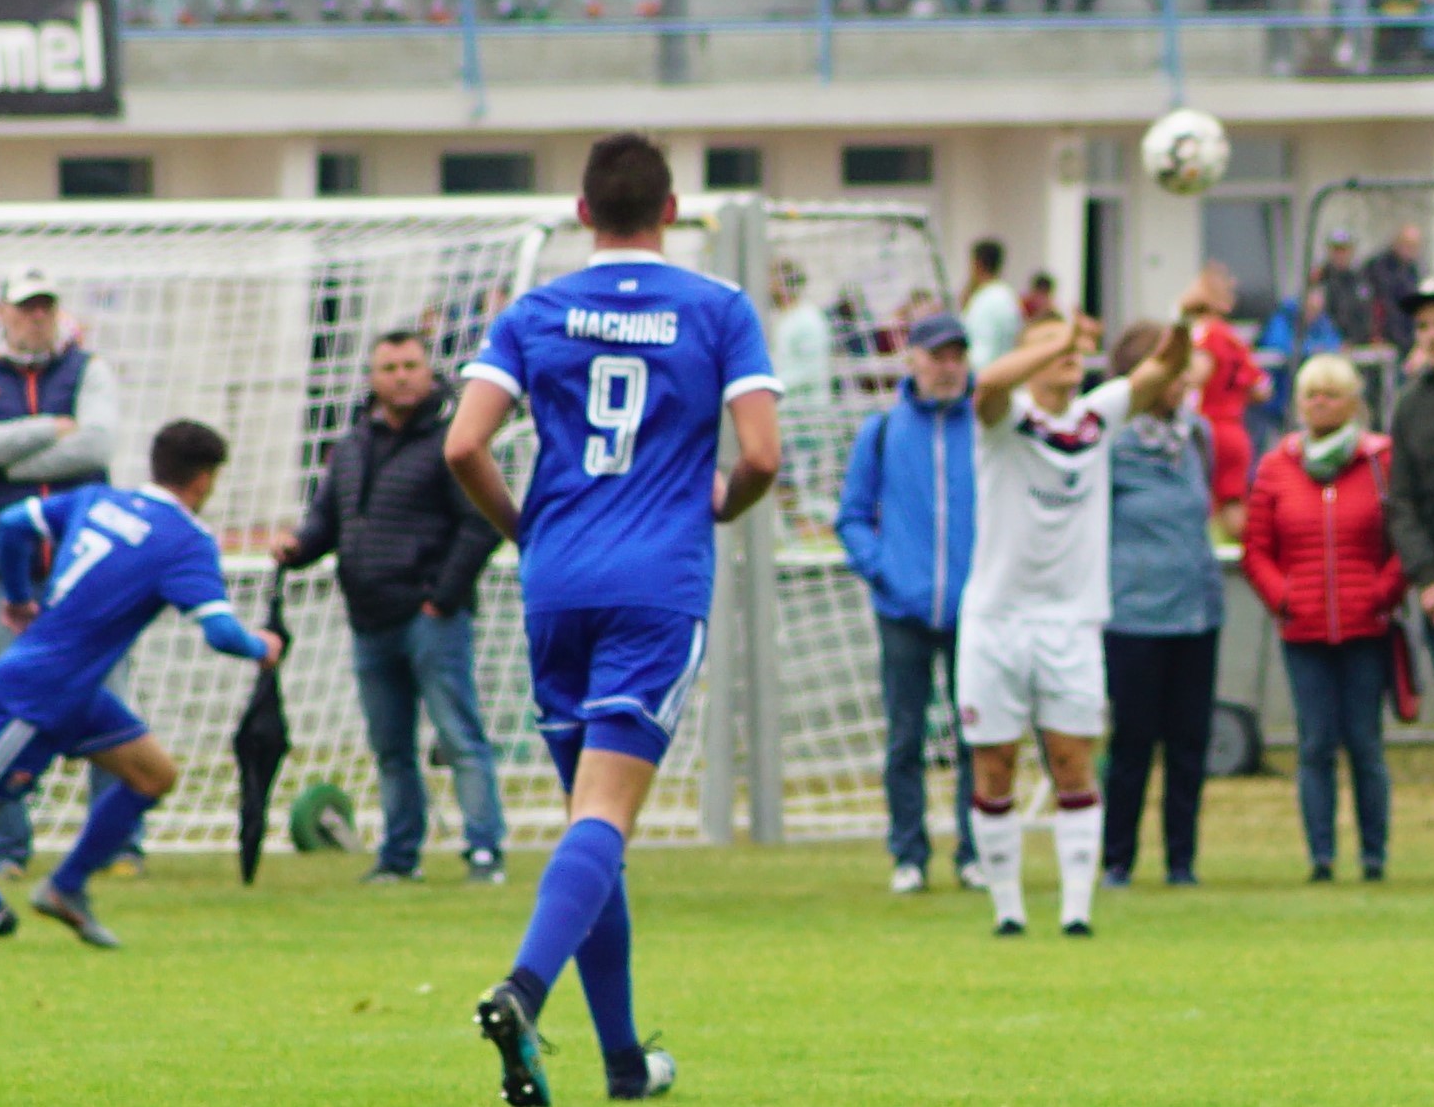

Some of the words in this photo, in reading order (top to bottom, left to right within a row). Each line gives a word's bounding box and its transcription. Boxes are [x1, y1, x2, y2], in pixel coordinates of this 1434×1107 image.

[567, 308, 678, 345] HACHING
[584, 354, 649, 476] 9
[46, 527, 114, 608] 7
